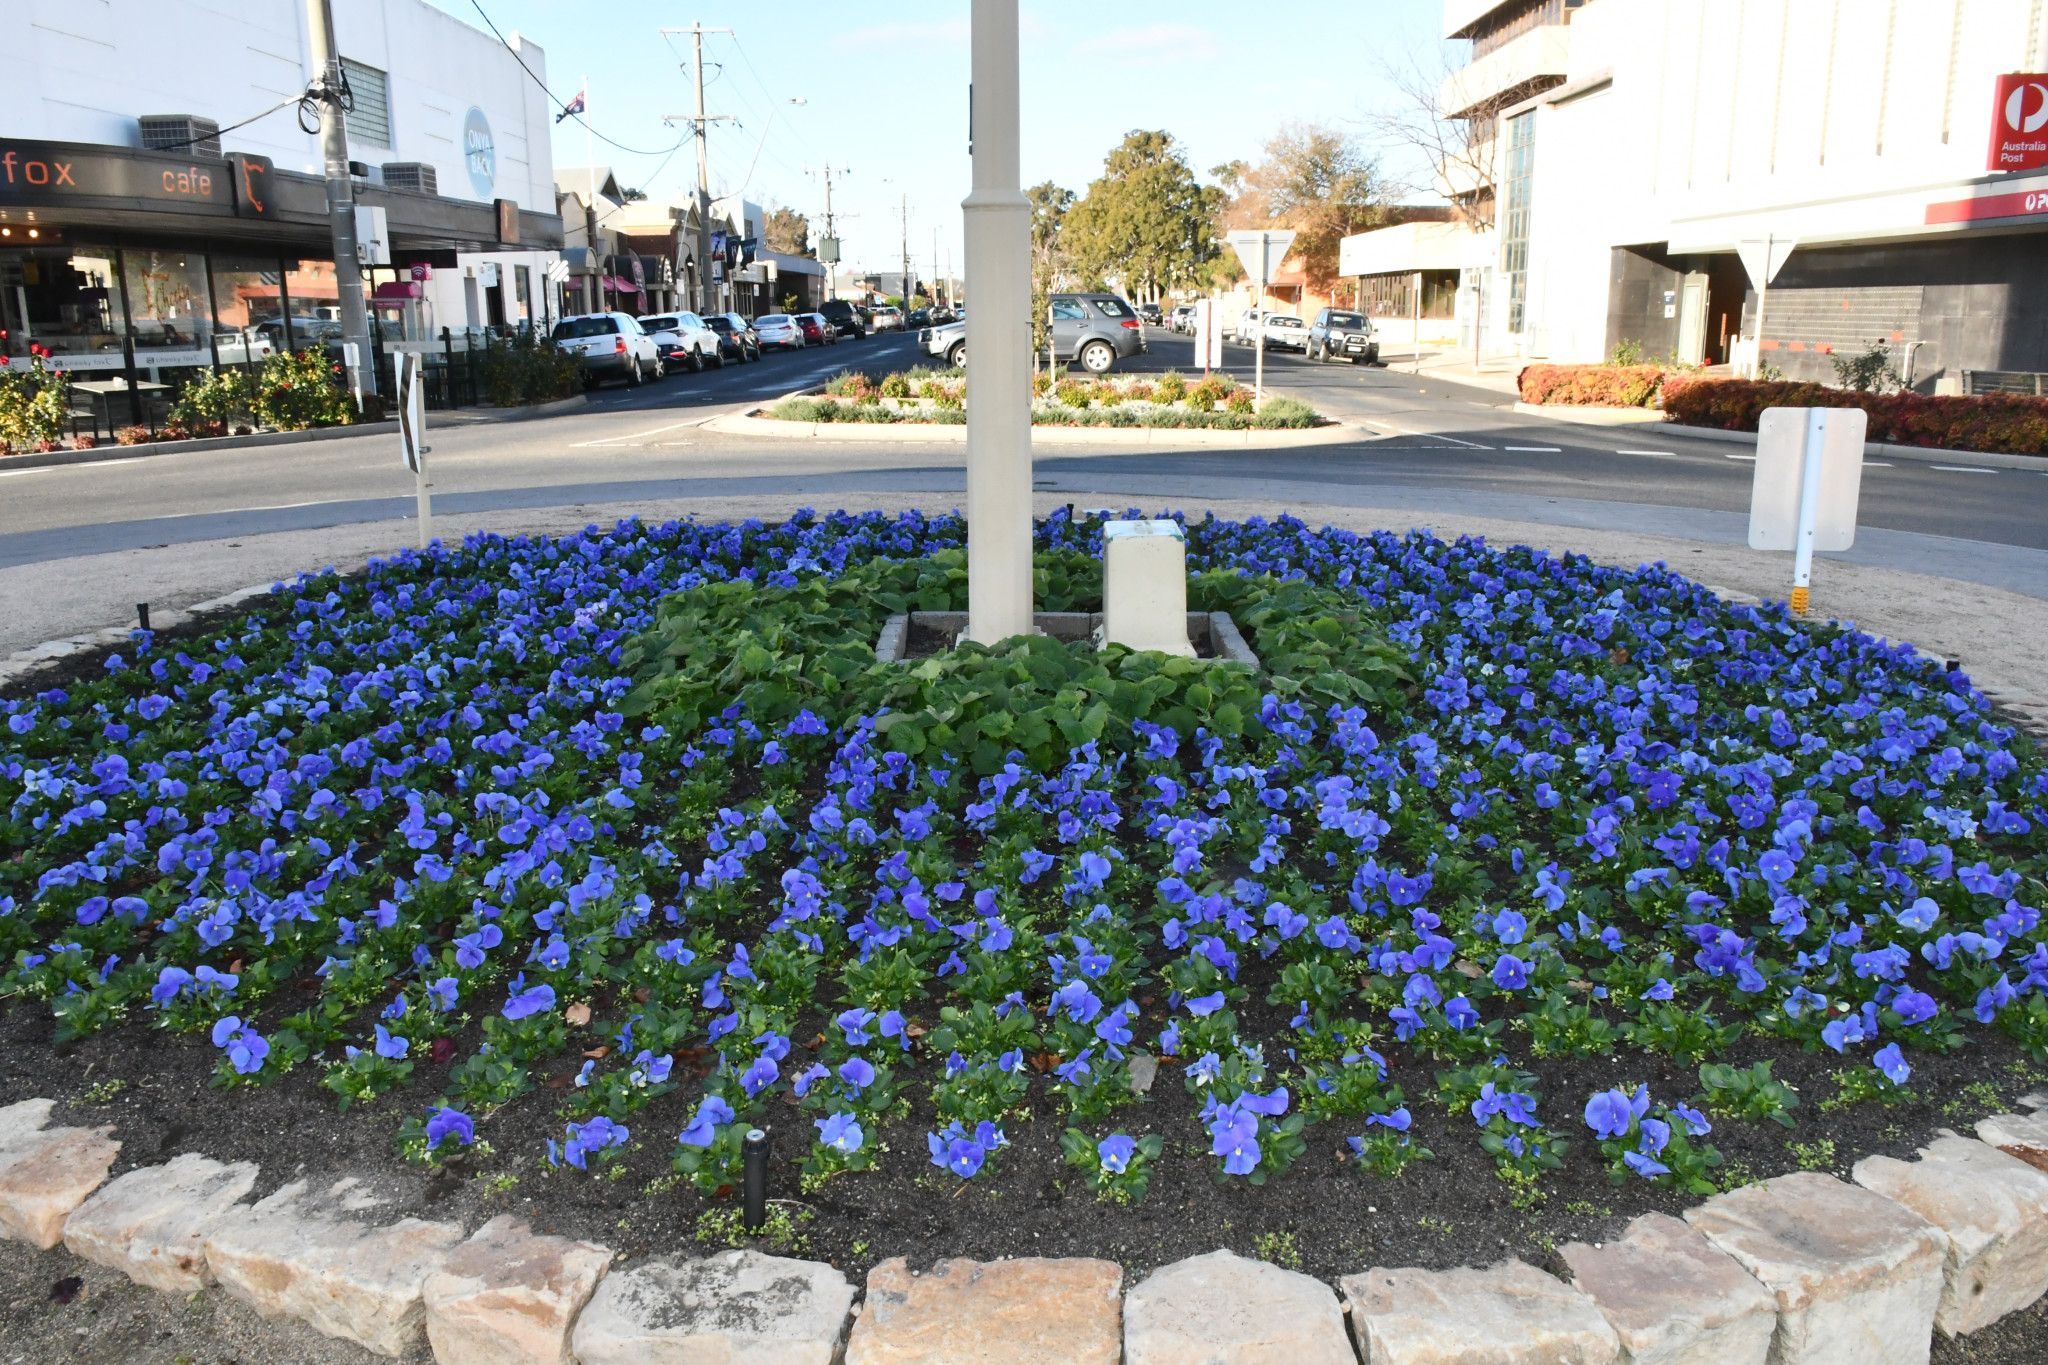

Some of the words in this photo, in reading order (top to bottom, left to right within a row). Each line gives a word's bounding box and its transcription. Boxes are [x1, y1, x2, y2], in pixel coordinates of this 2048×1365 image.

[2002, 141, 2046, 151] Australia
[2001, 153, 2024, 162] Post
[2, 151, 76, 186] fox
[162, 165, 212, 196] cafe
